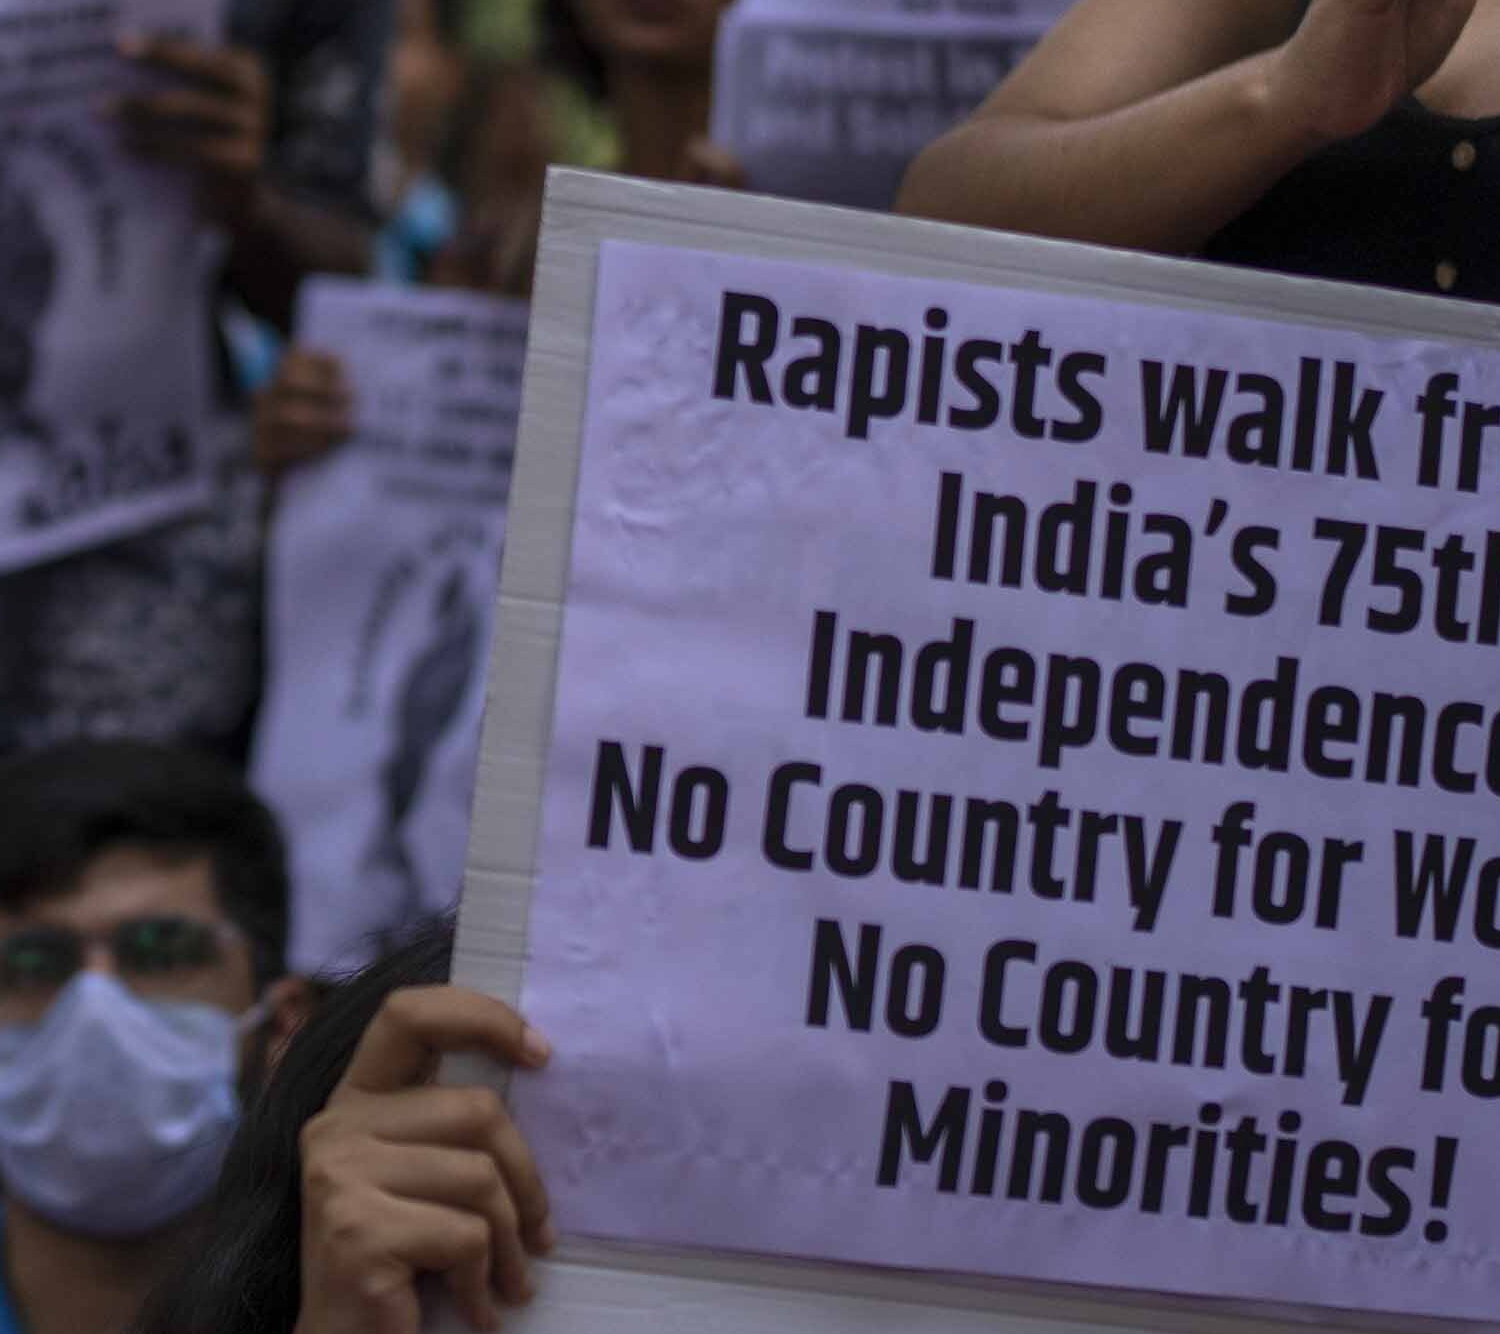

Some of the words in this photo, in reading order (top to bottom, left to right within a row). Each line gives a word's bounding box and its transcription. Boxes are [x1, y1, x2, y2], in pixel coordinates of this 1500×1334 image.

[714, 291, 1106, 443] Rapists
[1141, 357, 1384, 480] walk
[588, 741, 729, 860] No
[763, 762, 1183, 932] Country
[1212, 801, 1364, 929] for
[807, 919, 946, 1038] No
[979, 939, 1393, 1106] Country
[876, 1079, 1459, 1244] Minorities!
